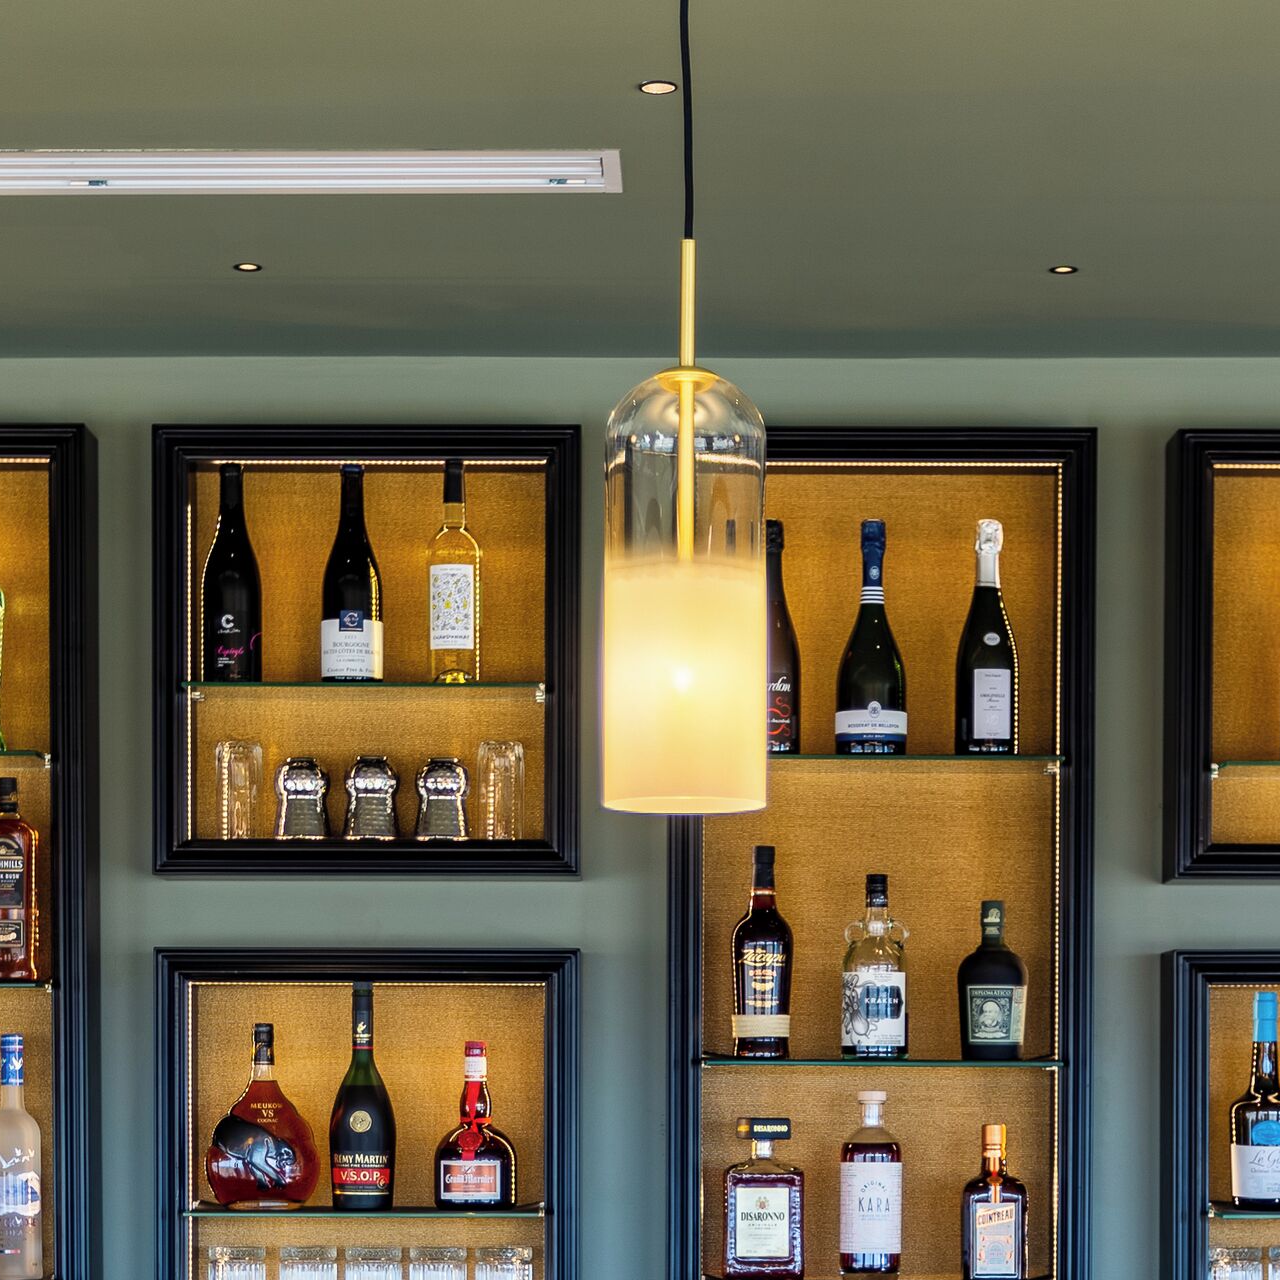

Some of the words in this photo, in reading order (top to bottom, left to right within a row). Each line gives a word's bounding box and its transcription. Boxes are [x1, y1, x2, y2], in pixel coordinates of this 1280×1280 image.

[768, 676, 792, 693] rdon
[261, 1109, 274, 1118] VS
[753, 1124, 788, 1133] DISARONNO
[355, 1153, 386, 1164] MARTIN
[1249, 1149, 1264, 1165] Le
[861, 1180, 888, 1193] ORIGINAL
[858, 1197, 890, 1212] KARA
[740, 1212, 785, 1222] DISARONNO
[977, 1208, 1014, 1226] COINTREAU
